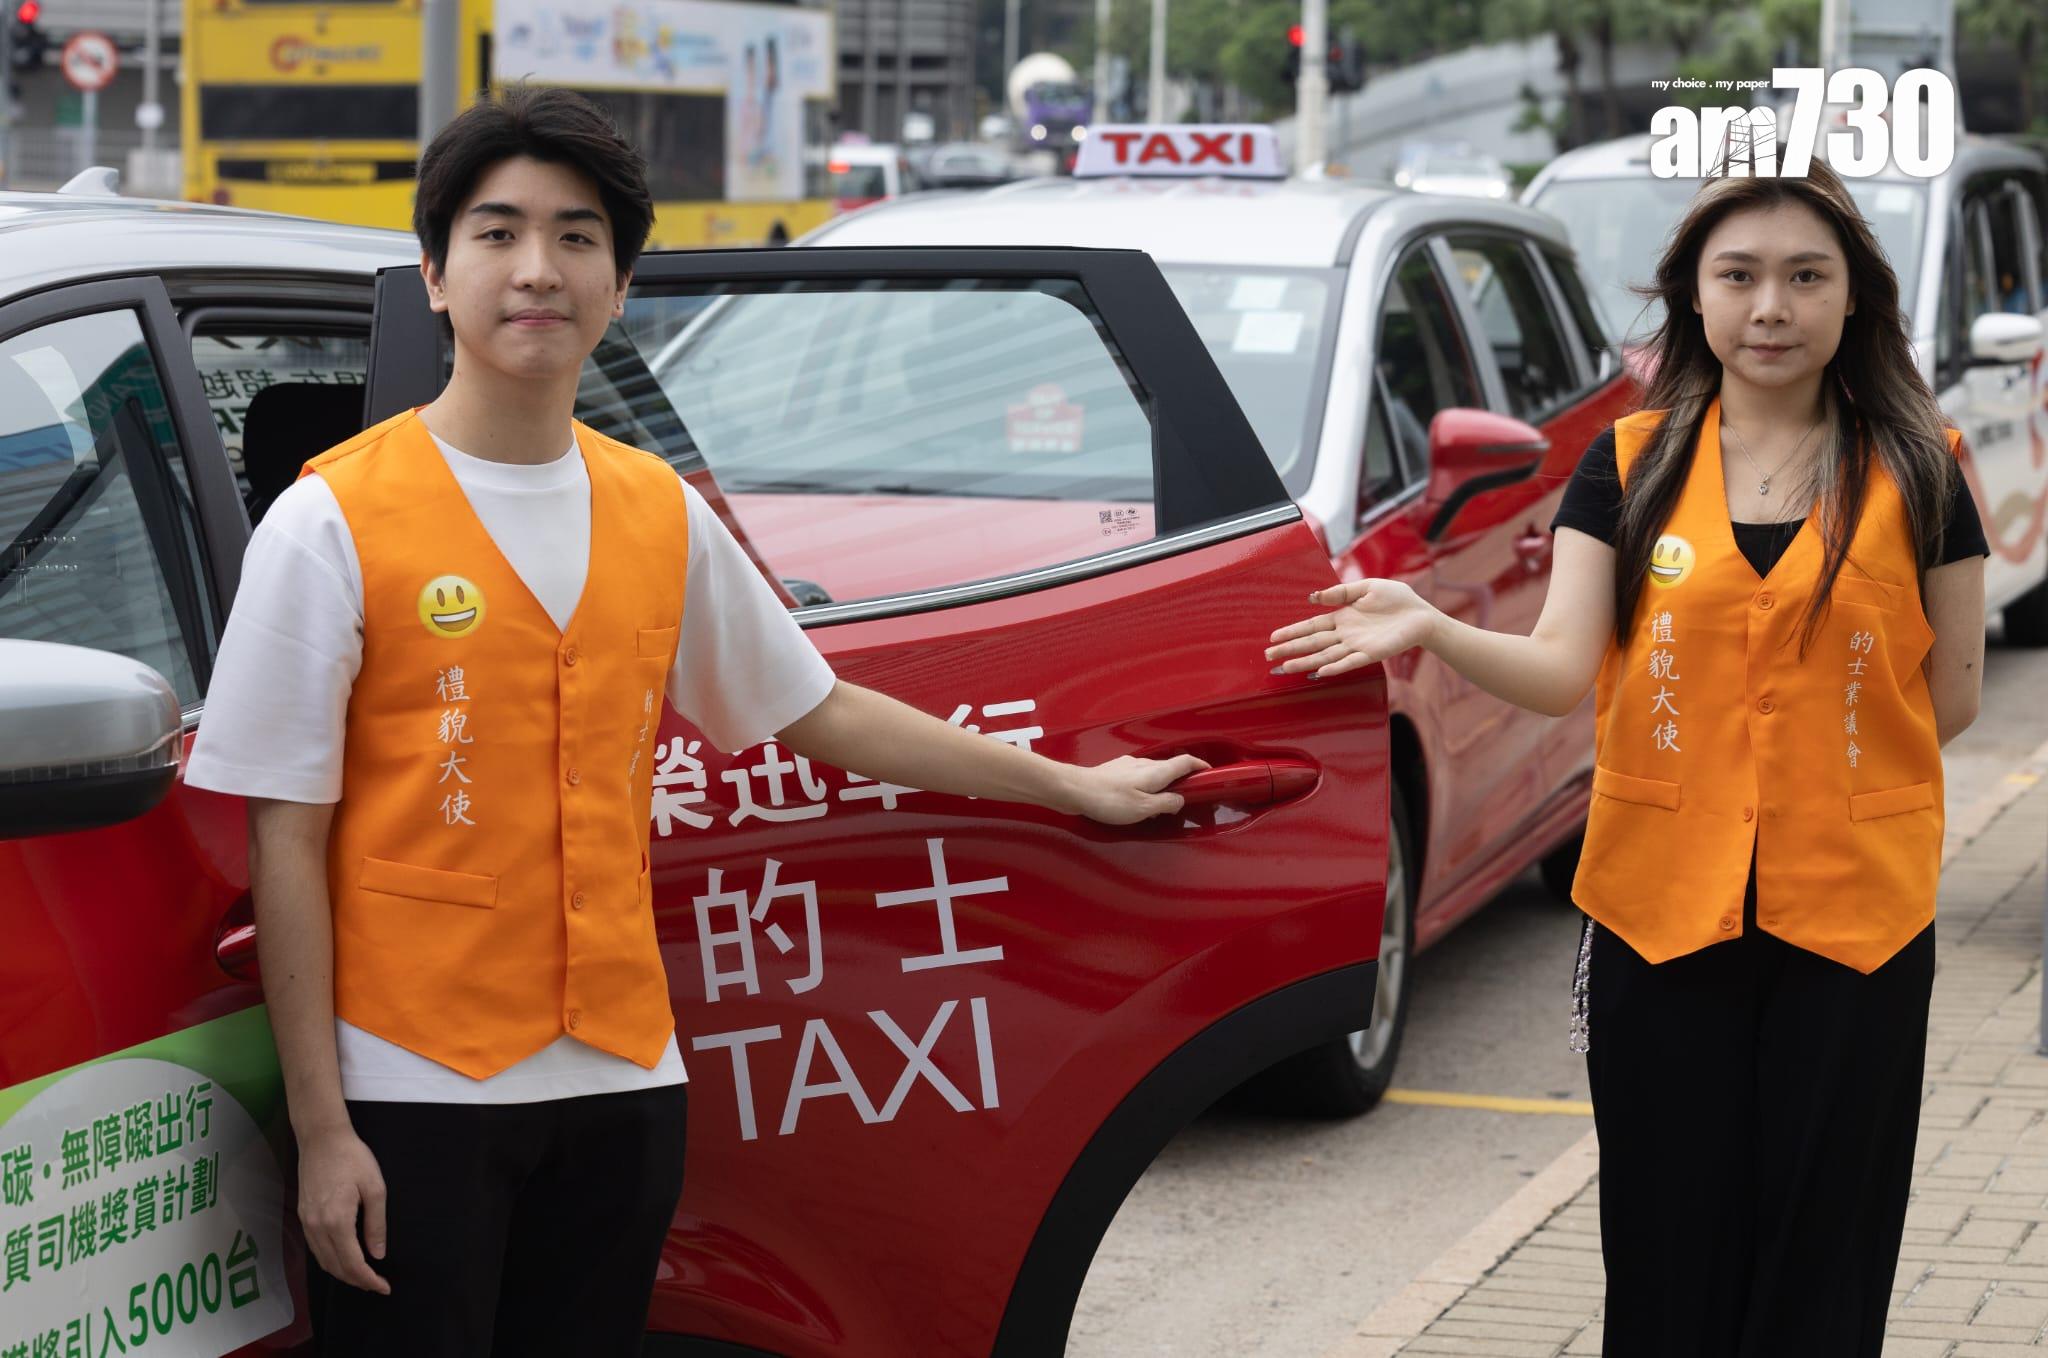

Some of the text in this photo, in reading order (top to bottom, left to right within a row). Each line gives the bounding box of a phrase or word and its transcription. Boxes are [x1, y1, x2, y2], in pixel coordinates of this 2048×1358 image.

[1100, 132, 1254, 165] TAXI
[436, 665, 476, 825] 禮貌大使
[1648, 611, 1681, 752] 禮貌大使
[1844, 631, 1874, 768] 的士業議會
[693, 838, 1009, 1003] 的士
[692, 997, 999, 1141] TAXI
